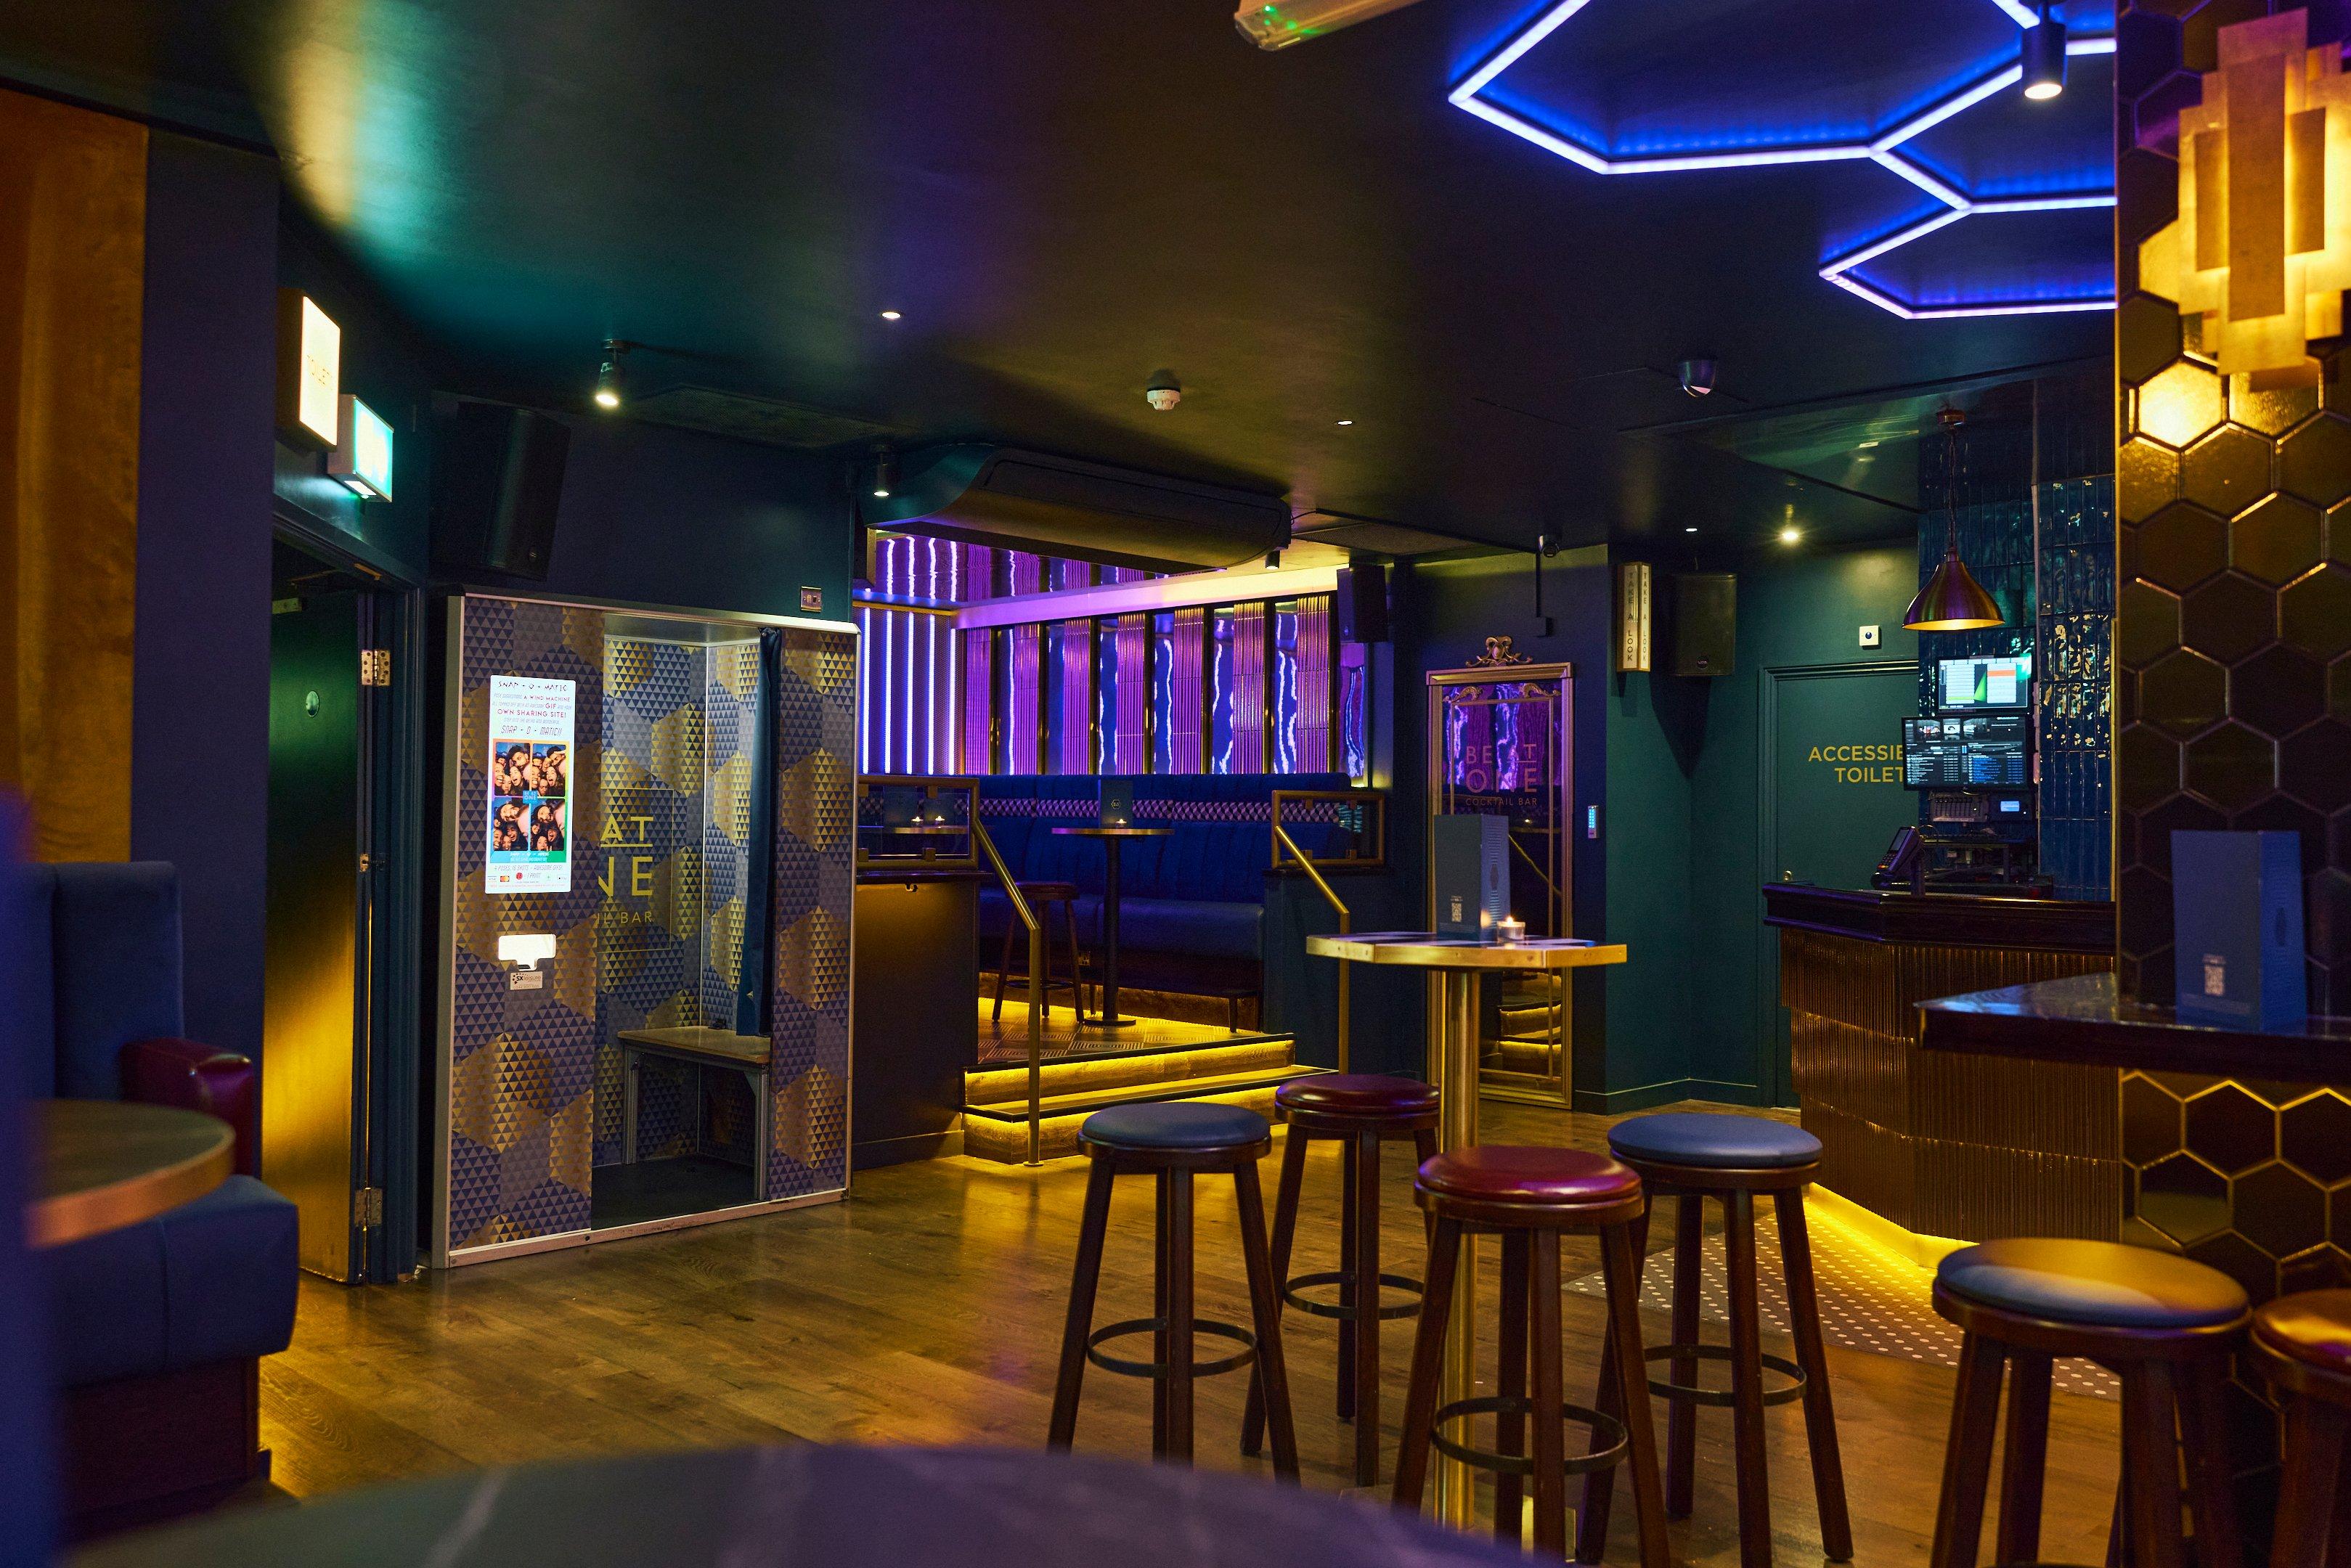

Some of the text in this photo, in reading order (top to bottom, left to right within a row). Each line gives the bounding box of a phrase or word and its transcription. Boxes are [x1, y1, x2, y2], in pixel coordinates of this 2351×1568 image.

[501, 725, 518, 734] SNAP
[1467, 746, 1492, 764] BE
[1467, 768, 1537, 793] ONE
[1834, 767, 1903, 783] TOILET
[600, 814, 653, 841] AT
[598, 857, 653, 897] NE
[621, 911, 652, 923] BAR
